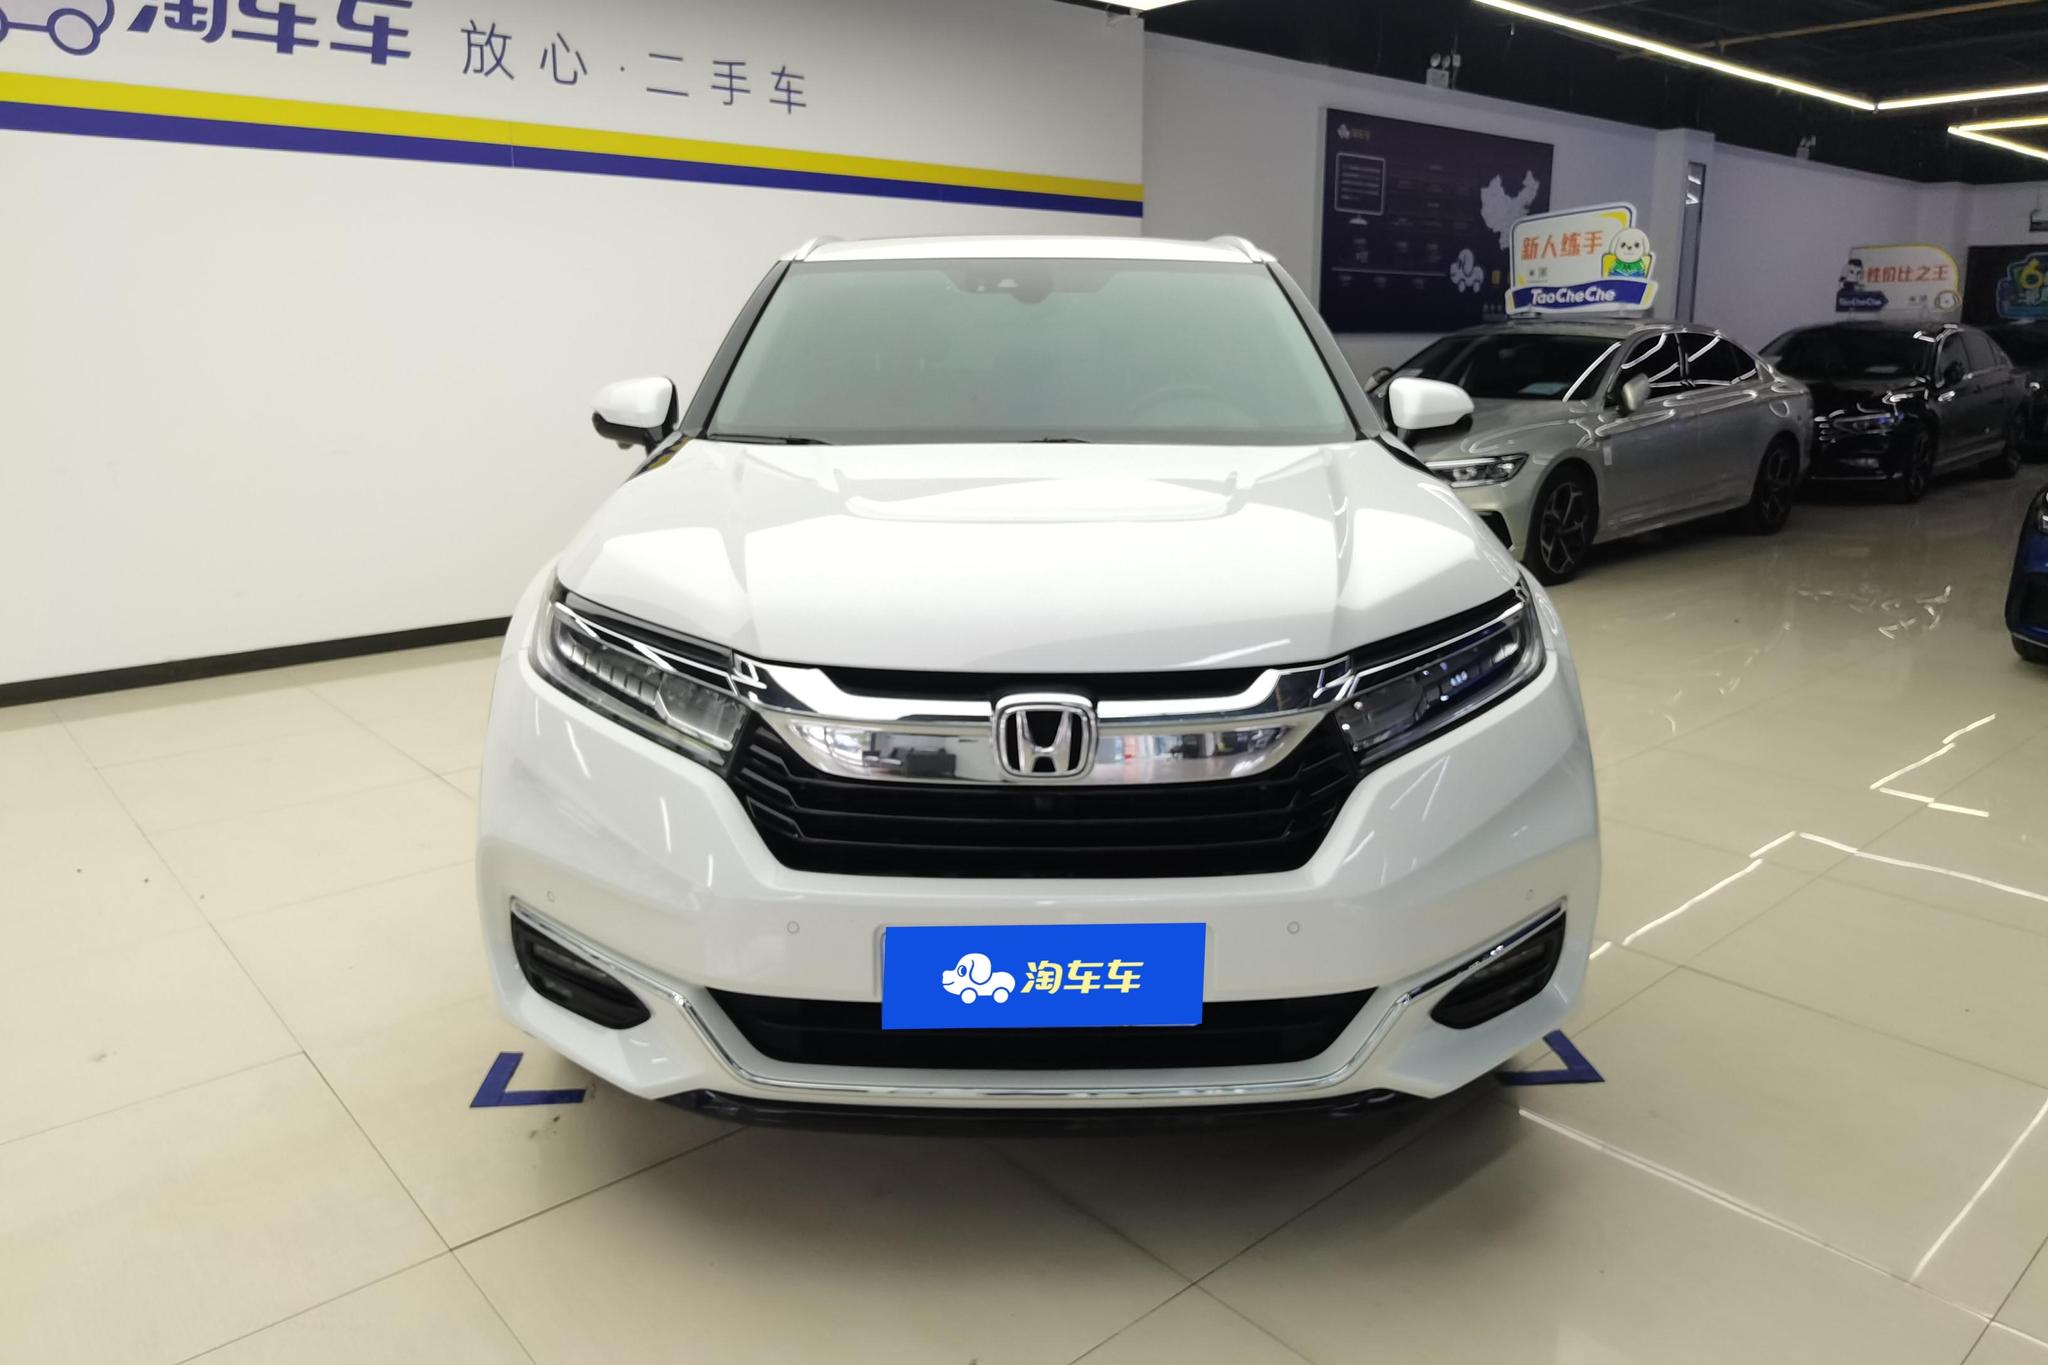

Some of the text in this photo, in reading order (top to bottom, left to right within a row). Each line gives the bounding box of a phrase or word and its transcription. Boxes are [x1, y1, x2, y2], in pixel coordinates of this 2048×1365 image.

[1521, 231, 1604, 261] 新人练手
[1530, 286, 1617, 305] TaoCheChe
